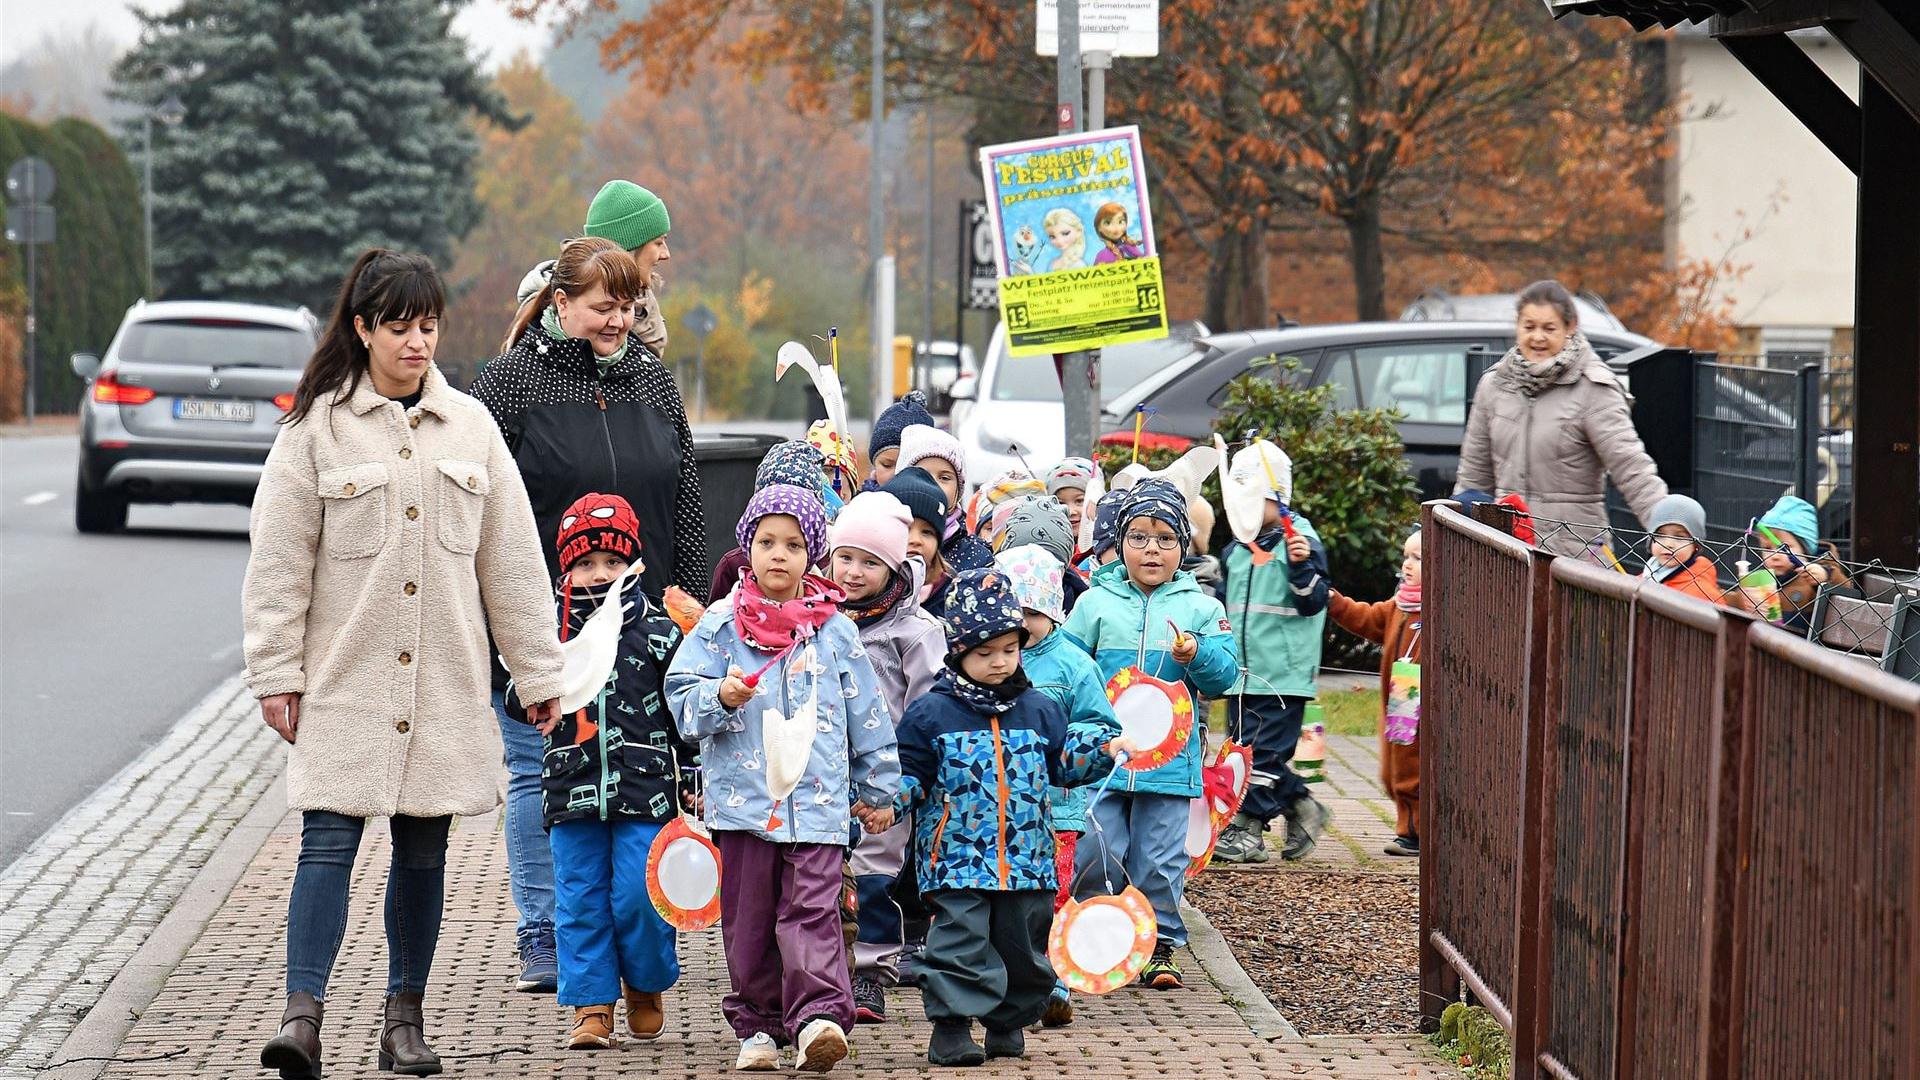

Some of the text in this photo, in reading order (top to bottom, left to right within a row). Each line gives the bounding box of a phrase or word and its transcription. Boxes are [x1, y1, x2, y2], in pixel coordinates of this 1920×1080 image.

[999, 146, 1129, 185] FESTIVAL
[1027, 147, 1094, 168] CIRCUS
[1003, 262, 1155, 290] WEISSWASSER
[1027, 277, 1132, 298] Festplatz Freizeitpark
[1139, 288, 1158, 308] 16
[1009, 307, 1028, 327] 13
